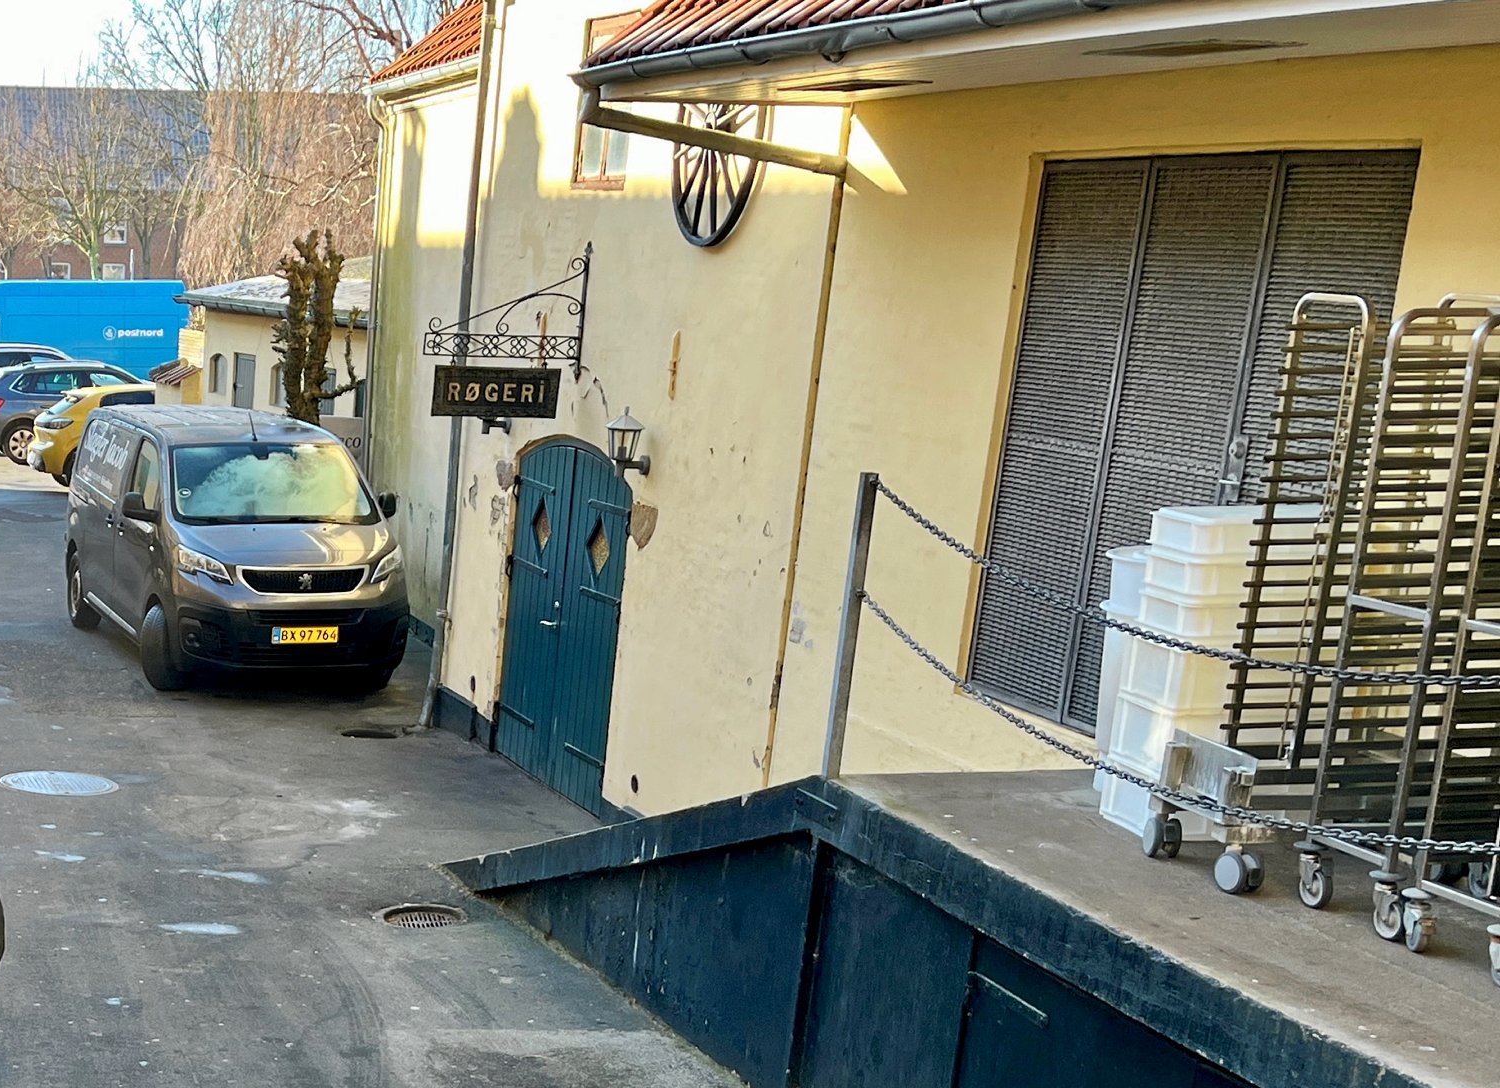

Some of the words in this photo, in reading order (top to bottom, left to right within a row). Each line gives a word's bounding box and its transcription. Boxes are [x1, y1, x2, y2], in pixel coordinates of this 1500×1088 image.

[118, 328, 164, 338] postnord
[300, 630, 313, 641] 97
[316, 629, 336, 640] 764
